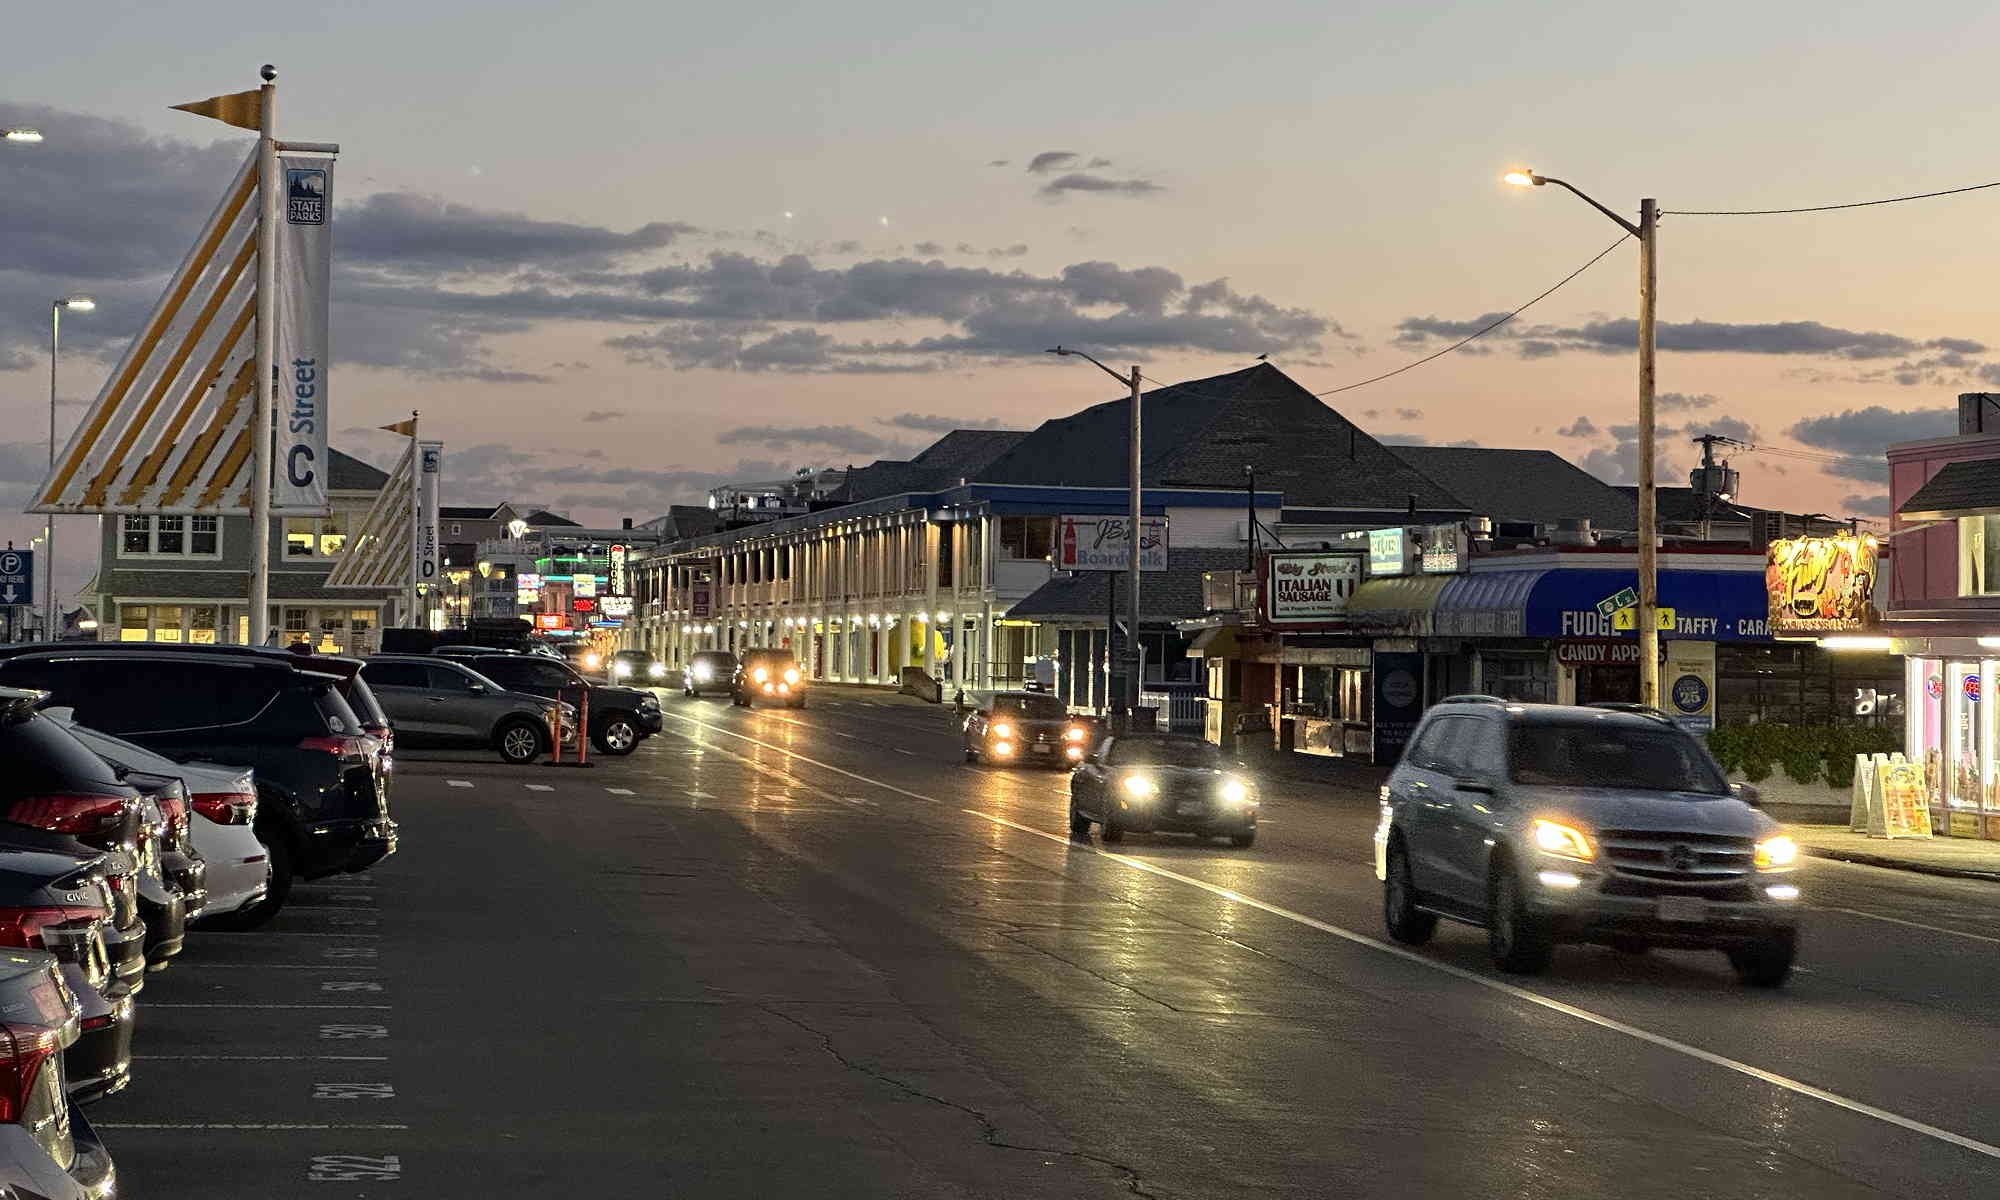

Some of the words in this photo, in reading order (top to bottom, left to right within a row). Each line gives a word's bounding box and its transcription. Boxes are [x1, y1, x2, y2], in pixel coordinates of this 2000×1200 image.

[290, 200, 321, 212] STATE
[290, 211, 321, 222] PARKS
[289, 358, 316, 435] Street
[287, 443, 315, 488] C
[423, 526, 435, 557] Street
[1078, 550, 1164, 567] Boardalk
[1278, 579, 1332, 593] ITALIAN
[1278, 591, 1332, 603] SAUSAGE
[1677, 617, 1718, 635] TAFFY
[1559, 643, 1606, 662] CANDY
[1611, 643, 1665, 662] APPS
